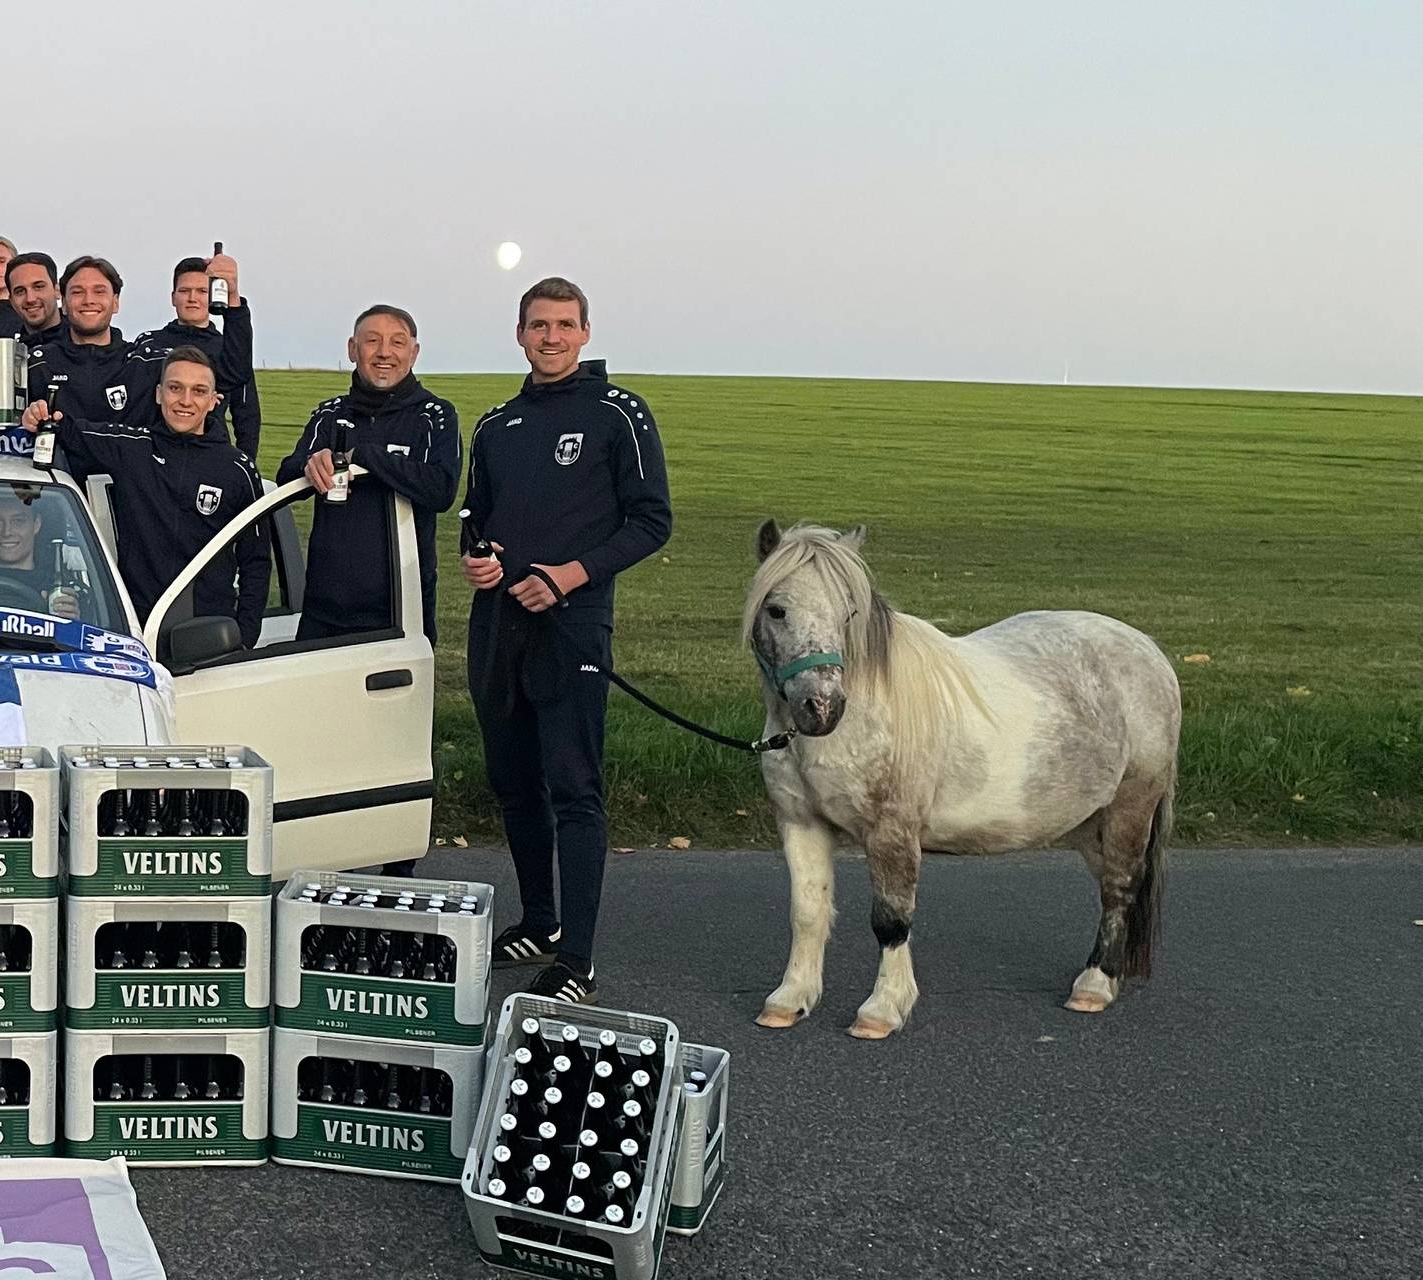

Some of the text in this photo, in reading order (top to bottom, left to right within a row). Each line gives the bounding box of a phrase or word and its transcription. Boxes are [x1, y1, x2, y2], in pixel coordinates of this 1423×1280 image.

[123, 852, 222, 875] VELTINS
[120, 984, 220, 1007] VELTINS
[325, 988, 429, 1019] VELTINS
[118, 1116, 218, 1140] VELTINS
[322, 1119, 424, 1152] VELTINS
[513, 1248, 605, 1279] VELTINS
